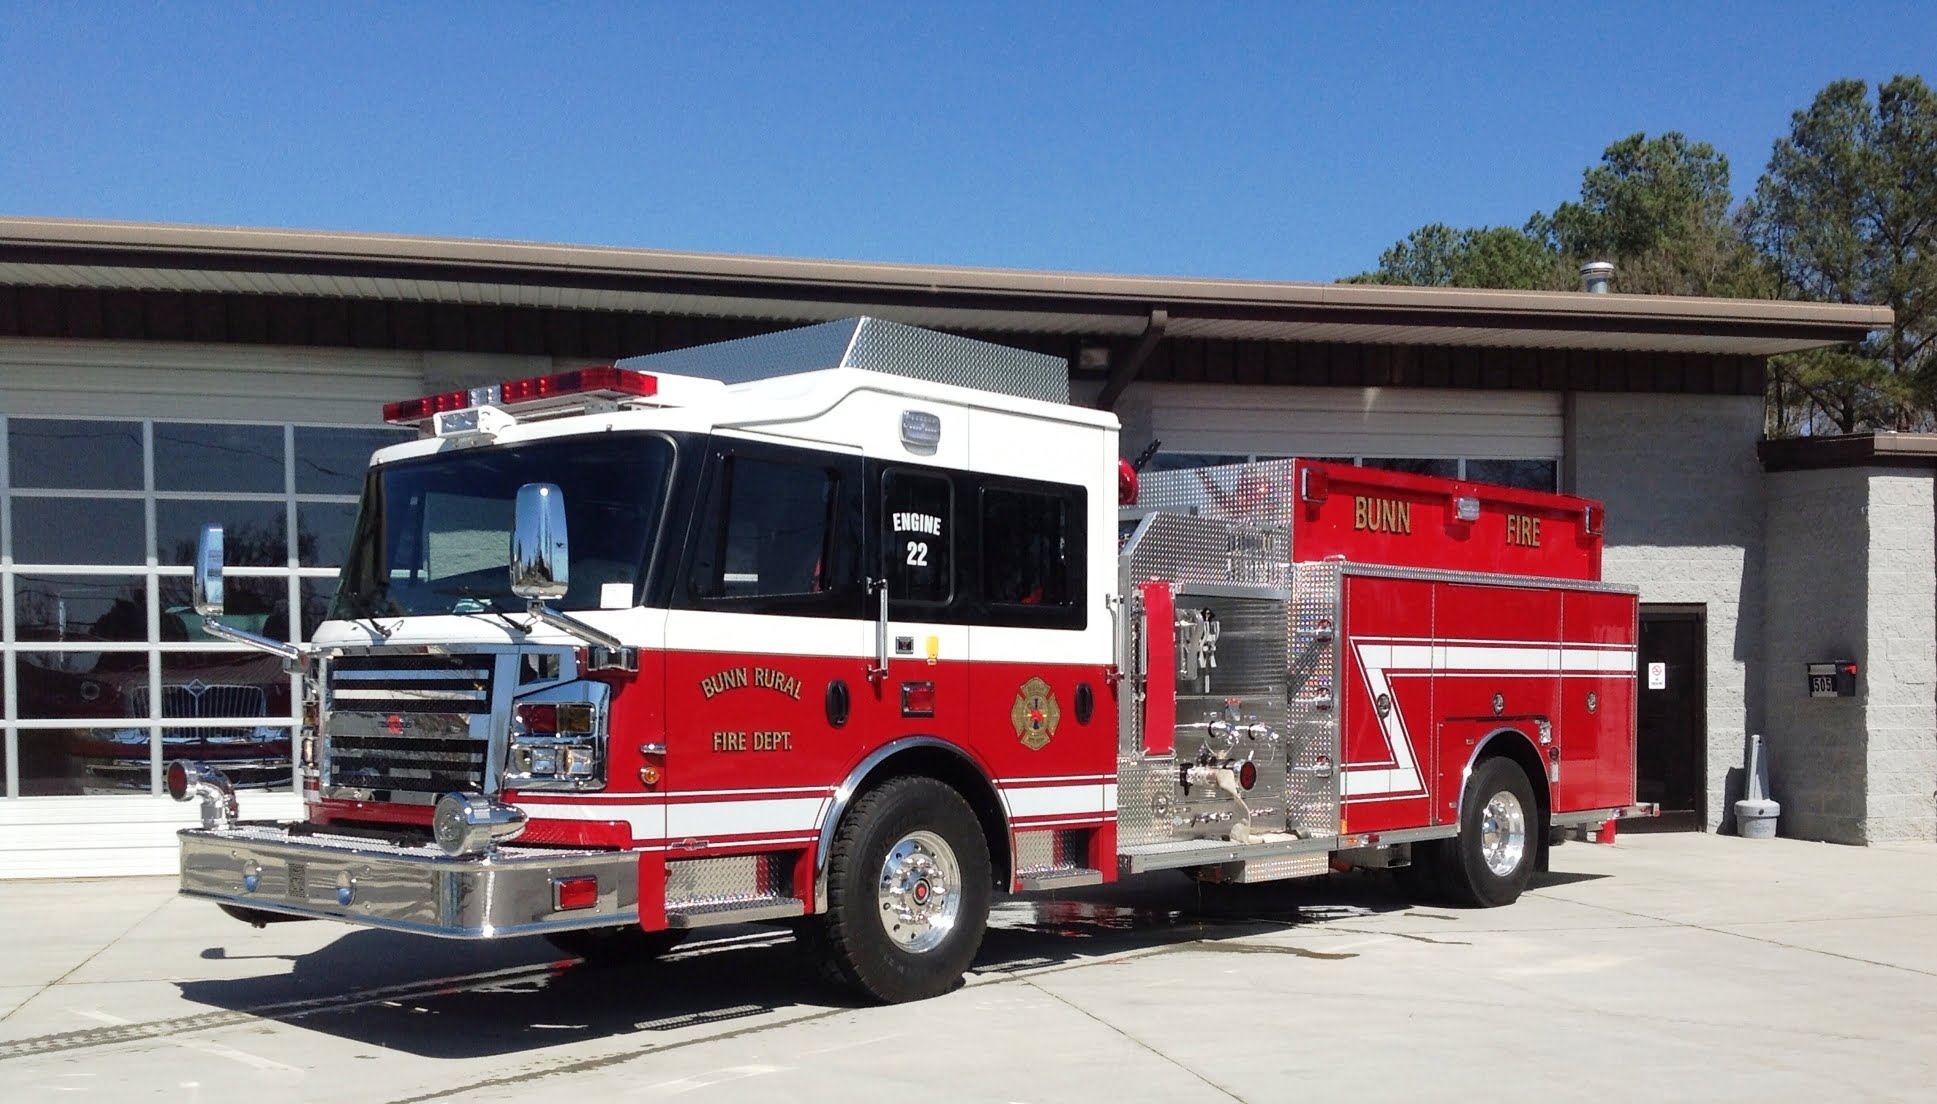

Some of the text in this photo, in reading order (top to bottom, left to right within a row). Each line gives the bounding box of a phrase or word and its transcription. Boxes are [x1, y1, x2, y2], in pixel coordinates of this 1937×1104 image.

[892, 512, 942, 536] ENGINE
[1354, 495, 1541, 548] BUNN FIRE
[906, 541, 928, 567] 22
[700, 667, 802, 700] BUNN RURAL
[1813, 677, 1831, 692] 505
[712, 731, 793, 752] FIRE DEPT.
